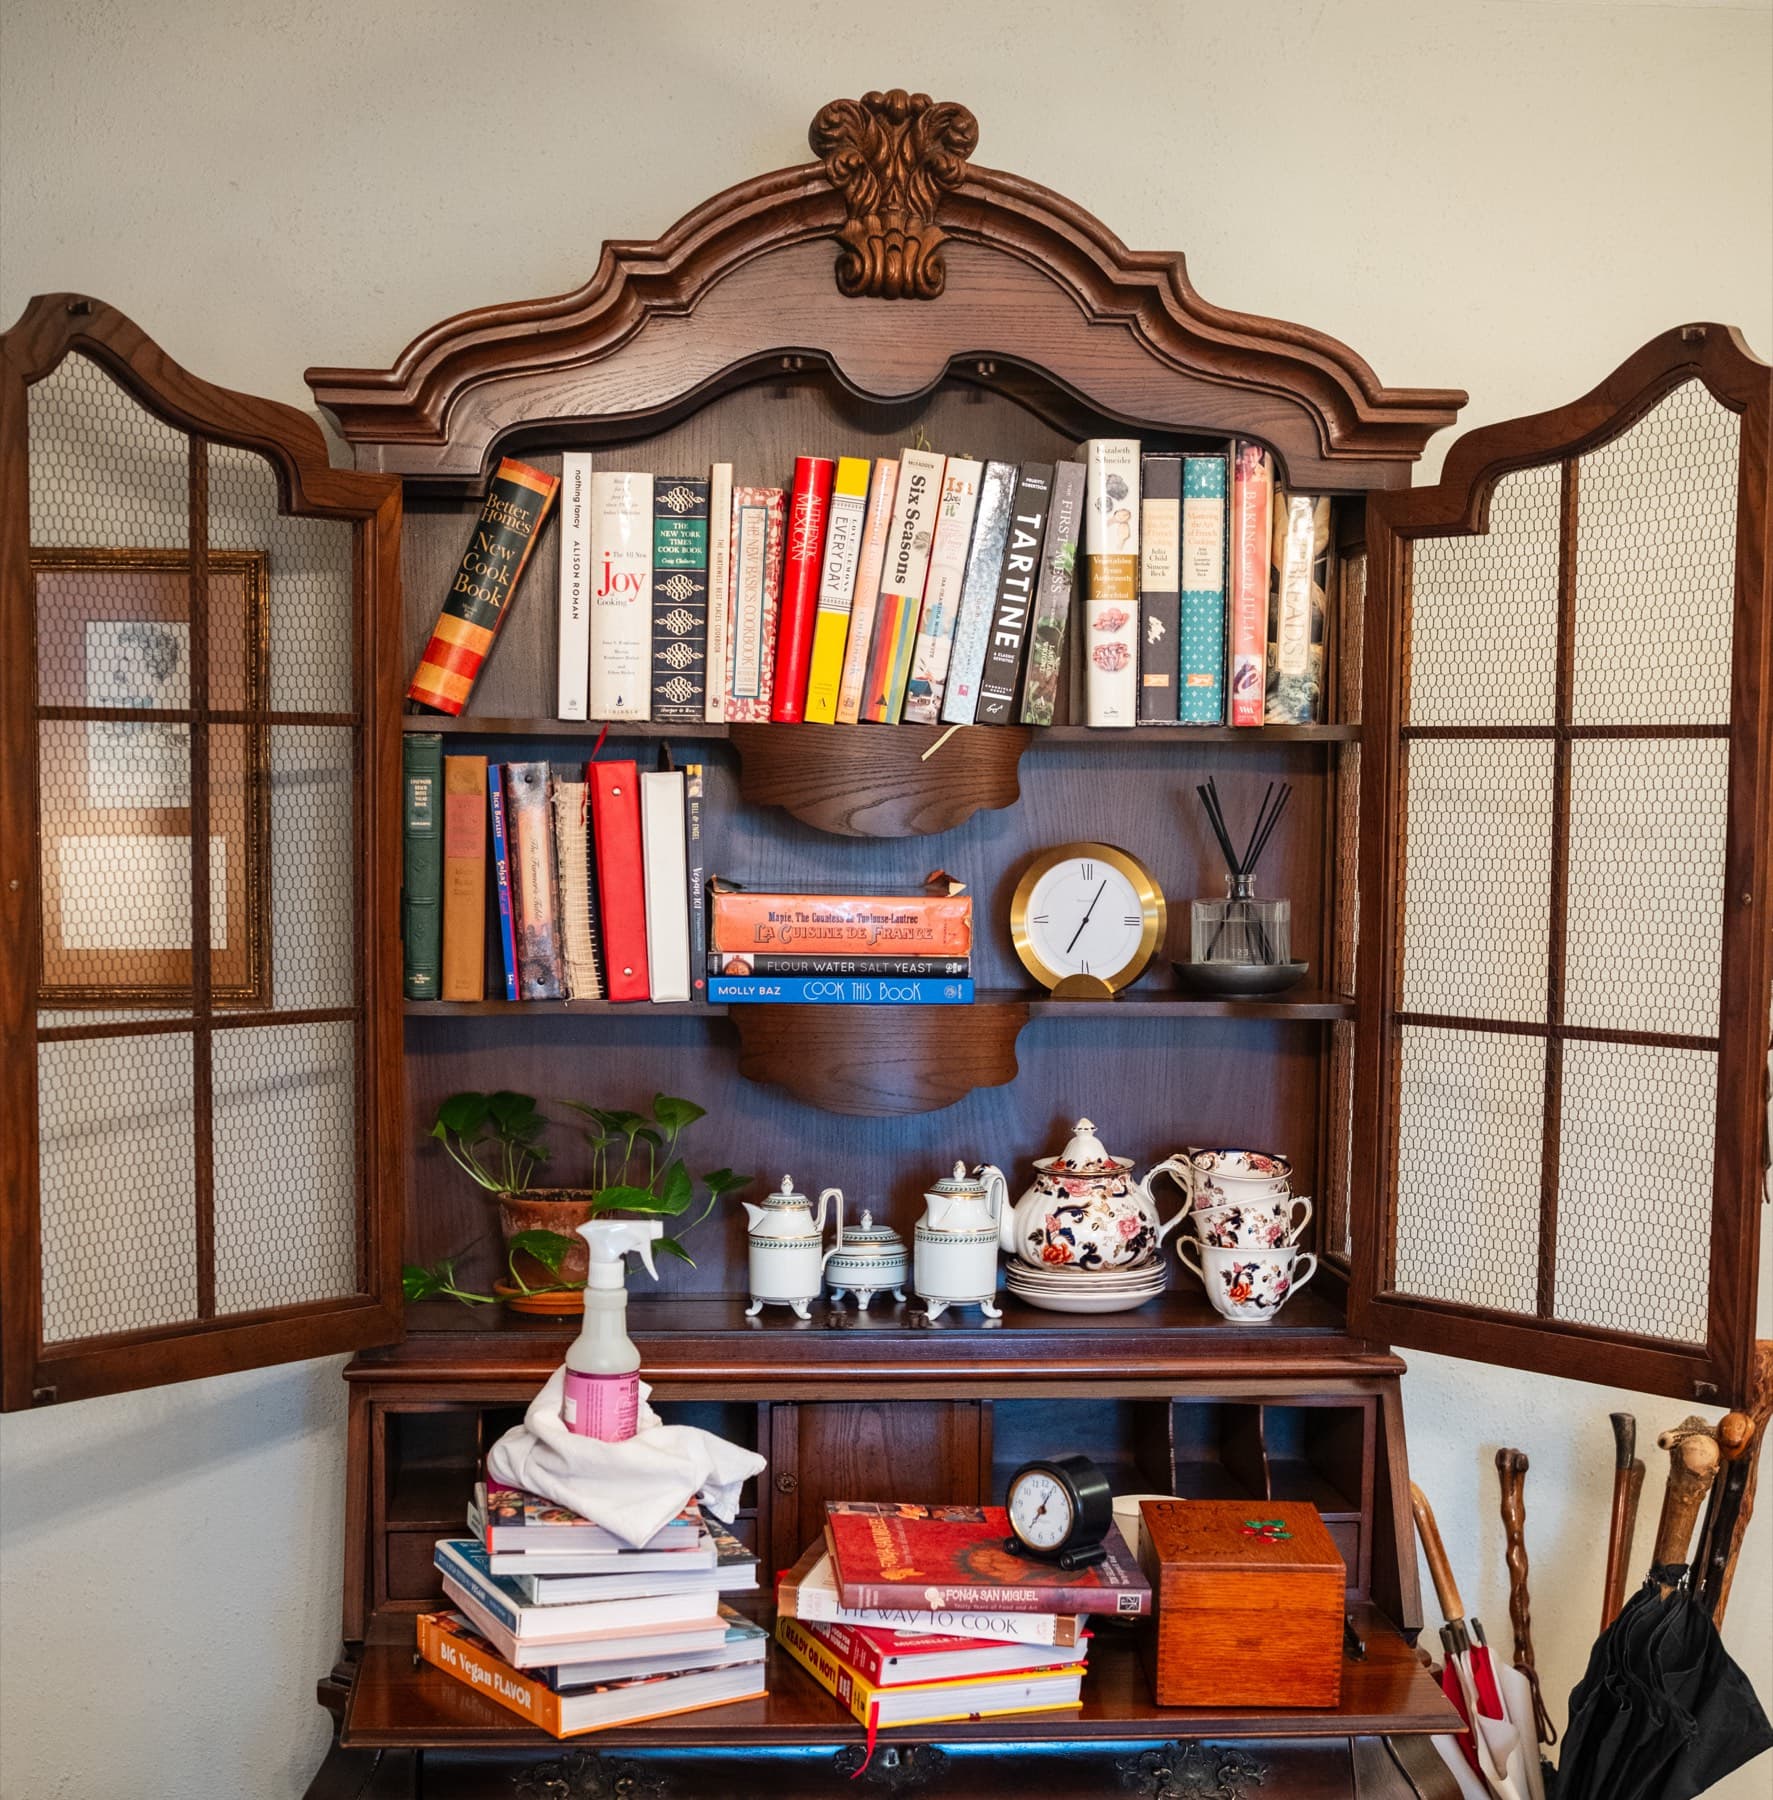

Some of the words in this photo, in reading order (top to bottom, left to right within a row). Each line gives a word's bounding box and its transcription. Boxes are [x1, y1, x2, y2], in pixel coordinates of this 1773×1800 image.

[1096, 446, 1130, 455] Ezabeth
[1096, 457, 1131, 465] Shneider
[572, 469, 581, 503] nothing
[908, 474, 926, 506] Six
[486, 492, 530, 520] Better
[572, 505, 580, 529] fancy
[481, 507, 532, 534] Homes
[746, 513, 761, 536] THE
[791, 493, 810, 561] MEXICAN
[806, 496, 821, 562] AUTHENTIC
[1057, 500, 1073, 542] FIRST
[1245, 490, 1257, 554] BAKING
[473, 531, 516, 561] New
[669, 538, 692, 546] TIMES
[717, 539, 725, 549] THE
[745, 539, 760, 562] NEW
[832, 516, 848, 557] EVERY
[895, 508, 921, 585] Seasons
[463, 552, 510, 586] Cook
[572, 540, 580, 580] ALISON
[716, 552, 724, 584] NORTHWEST
[1051, 550, 1065, 592] MESS
[1149, 554, 1168, 562] Child
[597, 551, 647, 602] Joy
[744, 567, 759, 602] BASICS
[826, 563, 842, 591] DAY
[842, 555, 853, 593] LEMONS
[995, 513, 1042, 649] TARTINE
[454, 573, 502, 607] Book
[572, 583, 580, 620] ROMAN
[597, 598, 627, 607] Cooking
[715, 587, 723, 600] BEST
[715, 603, 723, 622] PLACES
[1242, 592, 1257, 641] JULIA
[1283, 558, 1309, 657] BREADS
[714, 624, 722, 653] COOKBOOK
[741, 604, 758, 666] COOKBOOK
[494, 810, 502, 838] BAYLESS
[691, 867, 702, 896] Vegan
[693, 898, 702, 909] 101
[795, 912, 809, 923] The
[811, 912, 844, 923] Countess
[856, 912, 918, 925] Toulouse-Lautrec
[754, 923, 775, 943] LA
[779, 923, 843, 943] CUISINE
[848, 926, 867, 938] DE
[868, 924, 933, 945] FRANCE
[767, 961, 808, 972] FLOUR
[813, 962, 855, 973] WATER
[860, 962, 889, 973] SALT
[894, 962, 932, 974] YEAST
[718, 986, 755, 996] MOLLY
[758, 986, 781, 996] BAZ
[802, 982, 845, 1000] COOK
[852, 983, 872, 1000] THIS
[879, 982, 921, 1001] BOOK
[1023, 1488, 1031, 1496] 10
[1032, 1479, 1039, 1488] 11
[1041, 1479, 1050, 1488] 12
[980, 1590, 1000, 1601] SAN
[1001, 1590, 1039, 1602] MIGUEL
[882, 1609, 919, 1627] WAY
[928, 1611, 954, 1627] TO
[961, 1615, 1018, 1634] COOK
[786, 1625, 809, 1655] READY
[808, 1647, 818, 1667] OR
[819, 1656, 836, 1685] NOT!
[893, 1636, 951, 1648] MICHELLE
[441, 1642, 457, 1666] BIG
[459, 1652, 492, 1687] Vegan
[494, 1672, 531, 1710] FLAVOR
